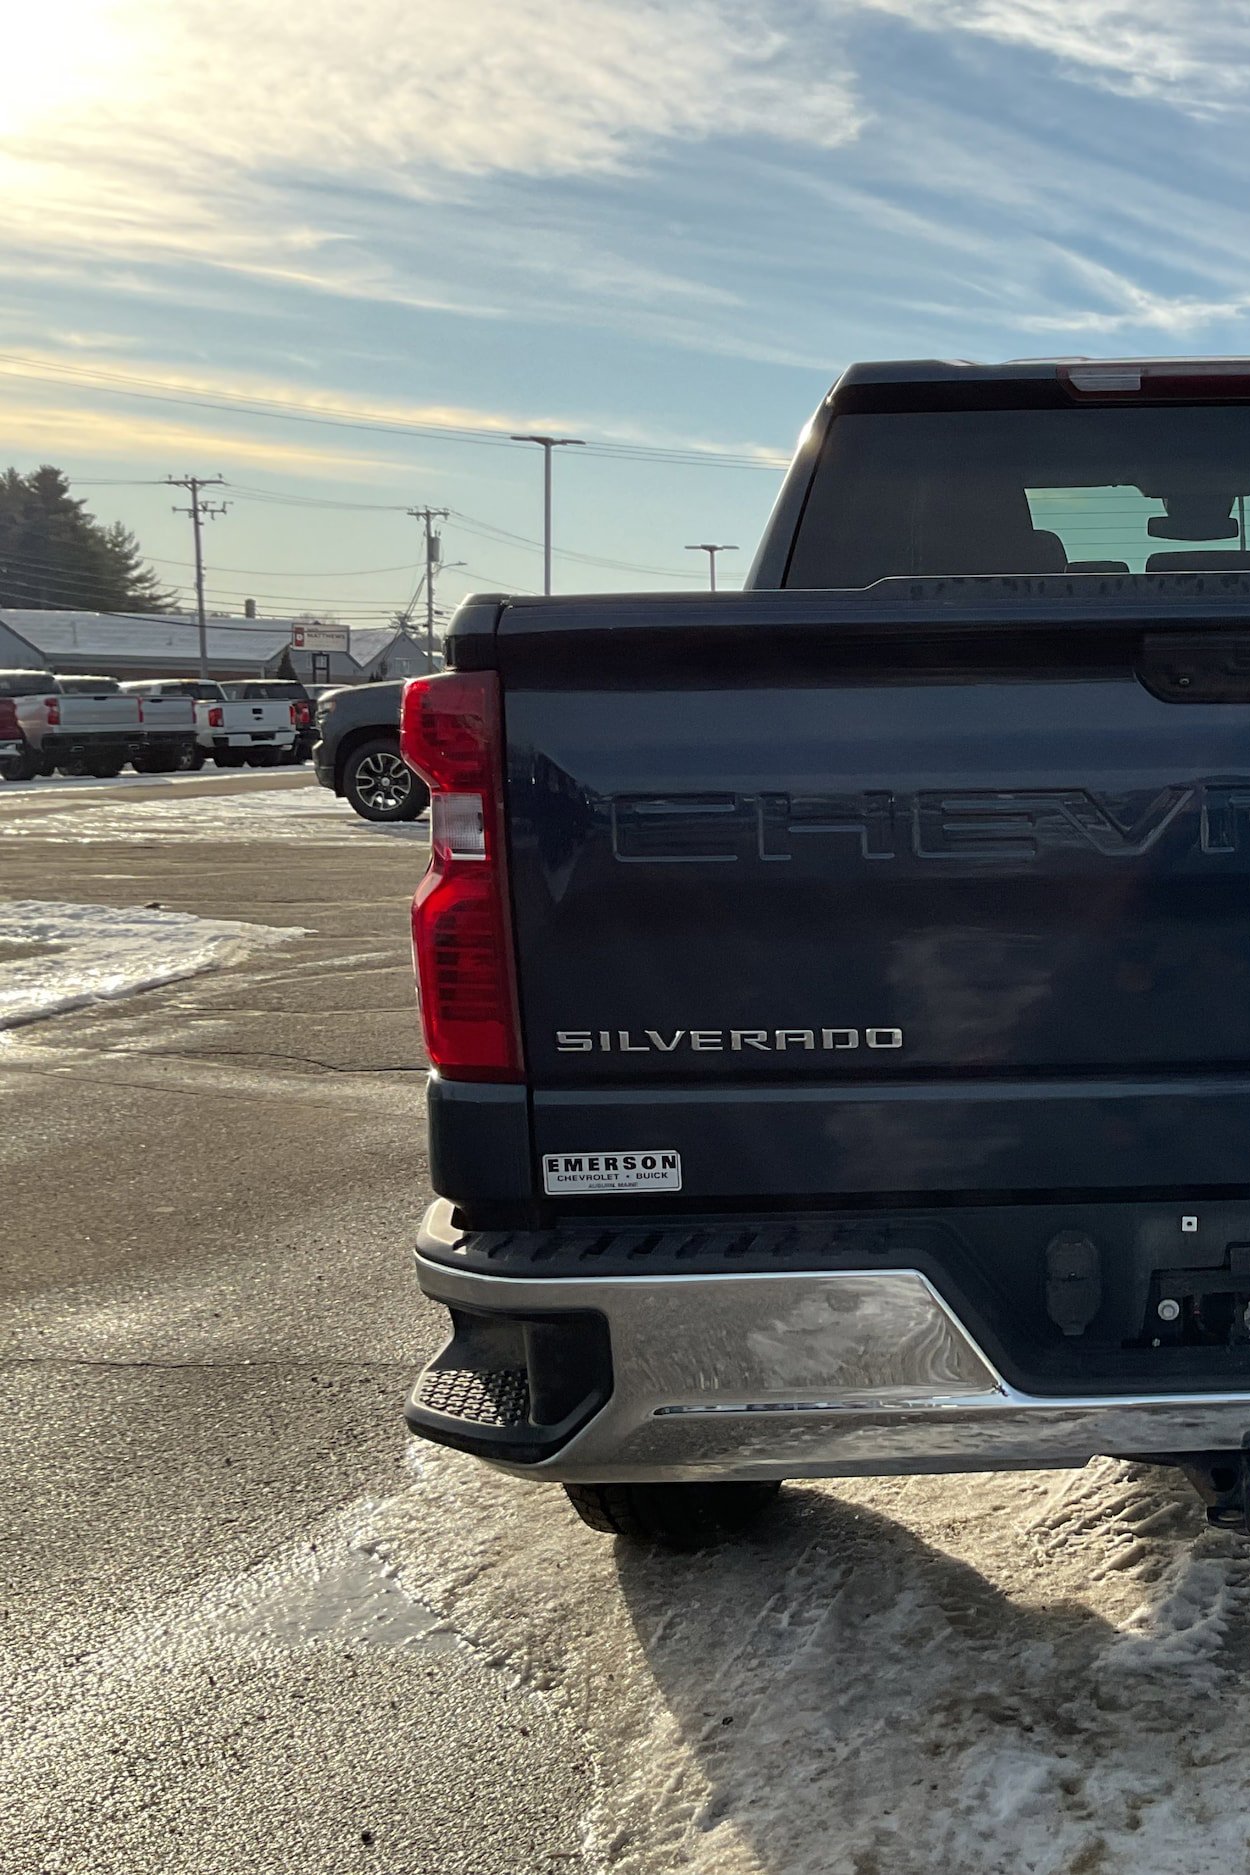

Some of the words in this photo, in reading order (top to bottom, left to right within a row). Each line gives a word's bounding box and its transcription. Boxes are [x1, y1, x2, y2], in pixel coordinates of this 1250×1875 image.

[555, 1027, 904, 1053] SILVERADO
[547, 1155, 677, 1173] EMERSON
[557, 1173, 620, 1182] CHEVROLET
[636, 1171, 669, 1180] BUICK
